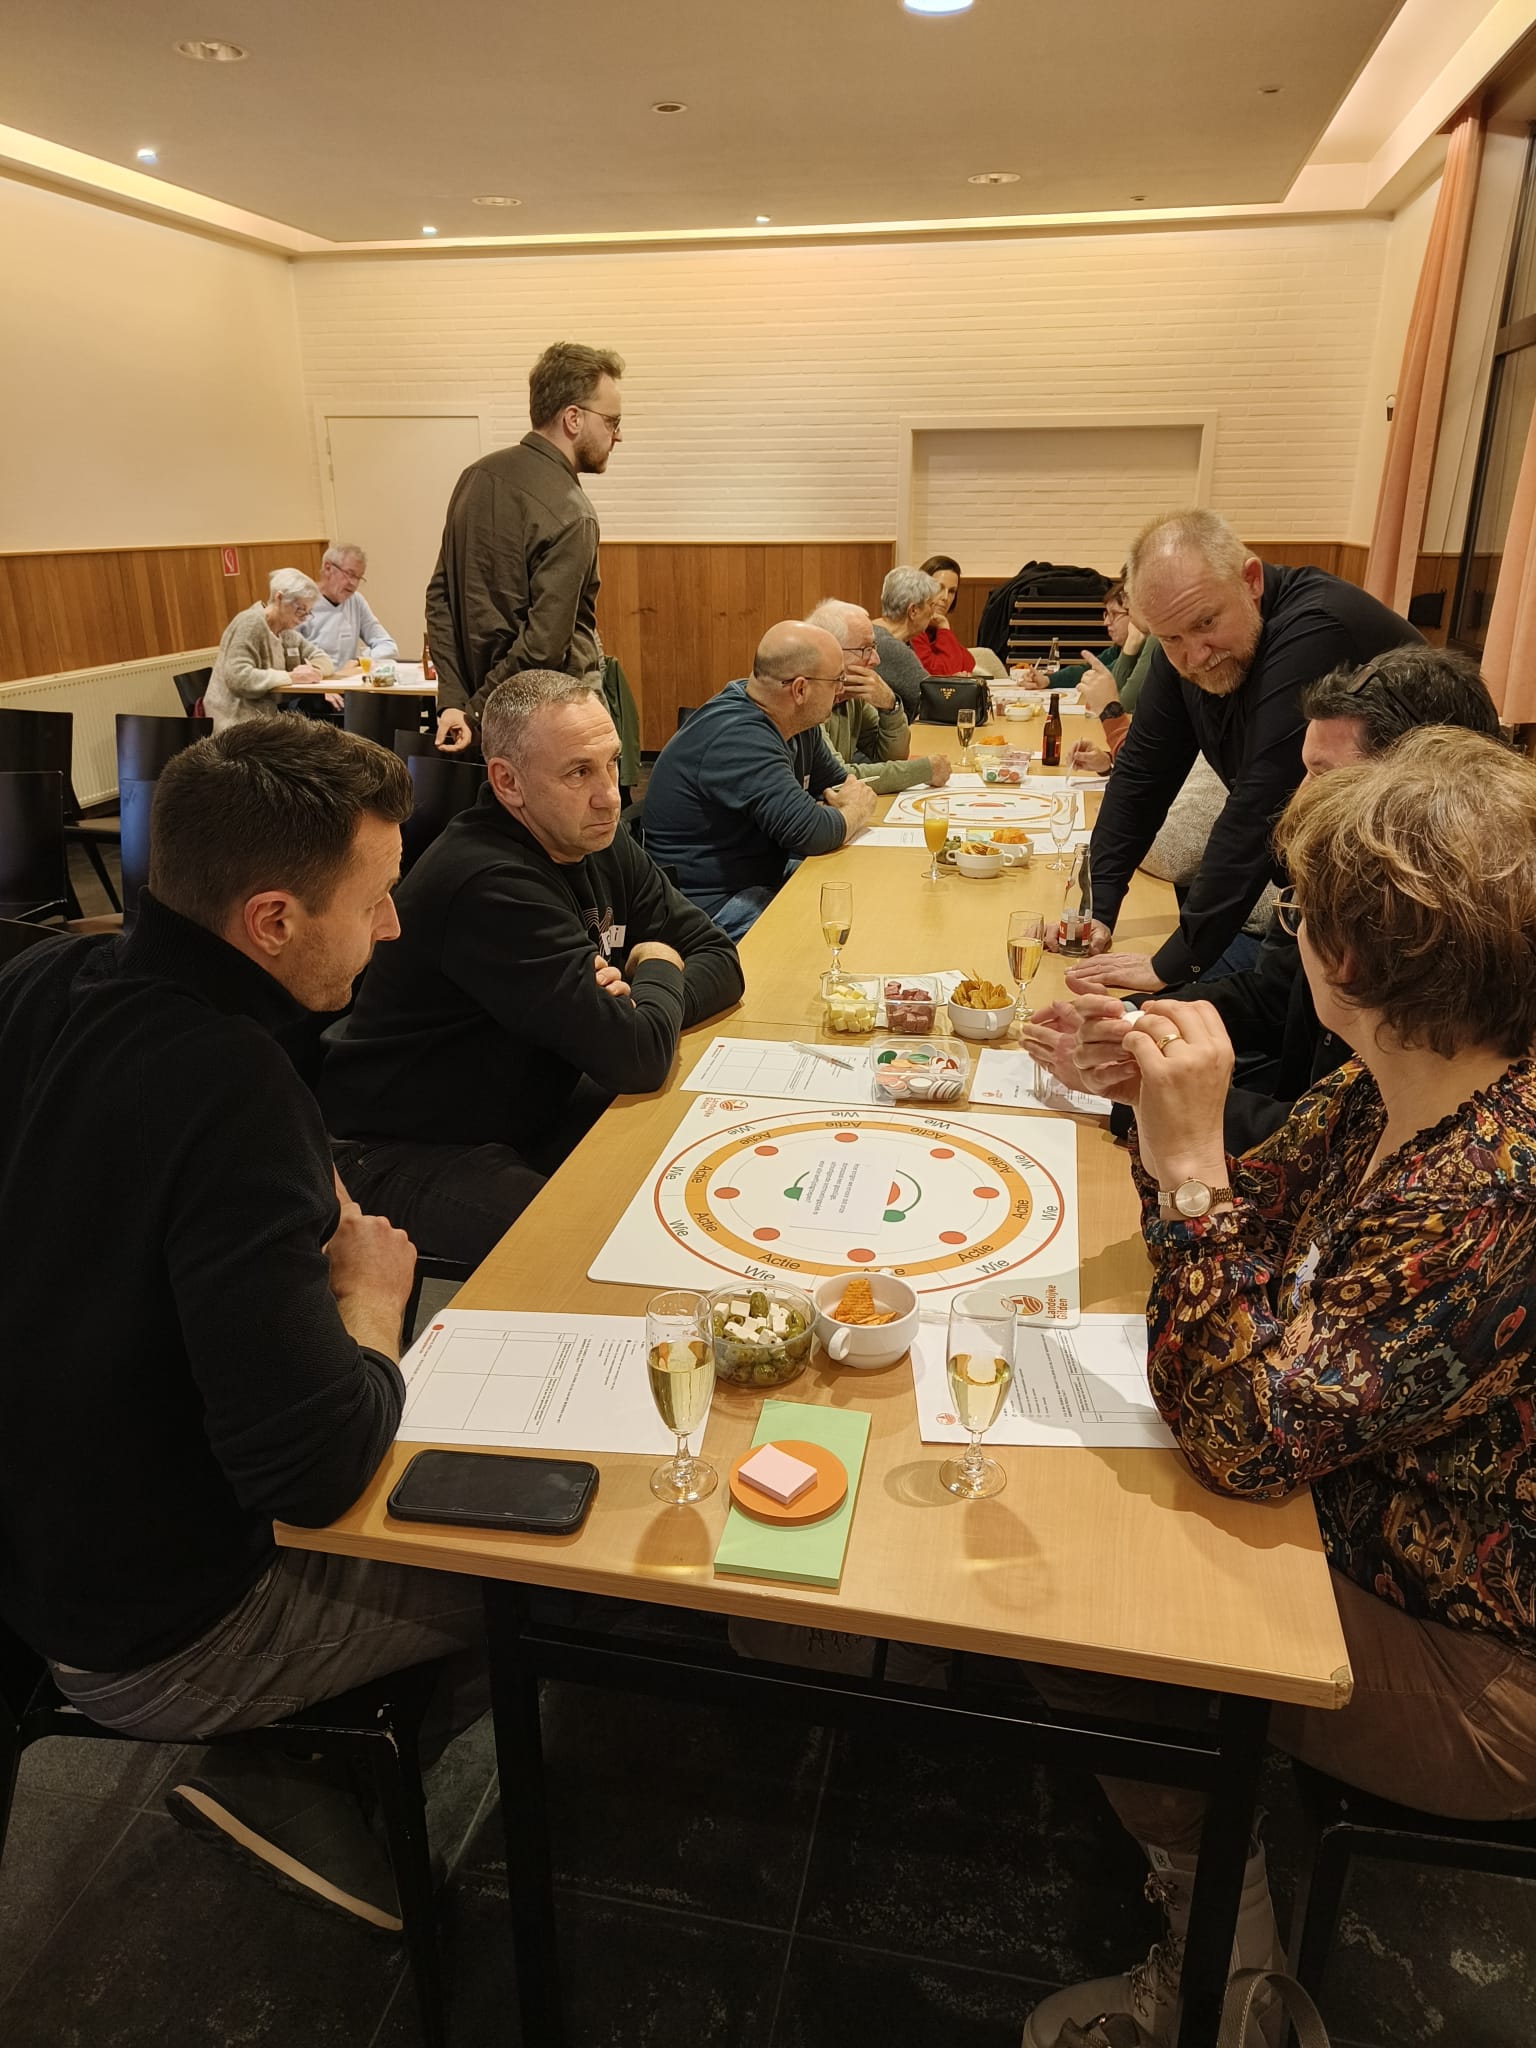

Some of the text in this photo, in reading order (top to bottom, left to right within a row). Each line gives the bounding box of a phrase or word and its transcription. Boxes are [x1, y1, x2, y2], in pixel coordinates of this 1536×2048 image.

[727, 1125, 756, 1135] Wie
[924, 1119, 950, 1130] Wie
[739, 1131, 771, 1145] Actie
[910, 1127, 946, 1140] Actie
[988, 1156, 1014, 1174] Actie
[1015, 1154, 1036, 1169] Wie
[665, 1166, 686, 1180] Wie
[691, 1164, 713, 1184] Actie
[1012, 1199, 1029, 1220] Actie
[1041, 1205, 1058, 1221] Wie
[669, 1219, 689, 1237] Wie
[694, 1212, 718, 1232] Actie
[958, 1244, 994, 1262] Actie
[757, 1253, 801, 1270] Actie
[976, 1259, 1010, 1274] Wie
[744, 1265, 776, 1280] Wie
[1045, 1284, 1058, 1319] Landelijke
[1056, 1298, 1068, 1320] Gilden
